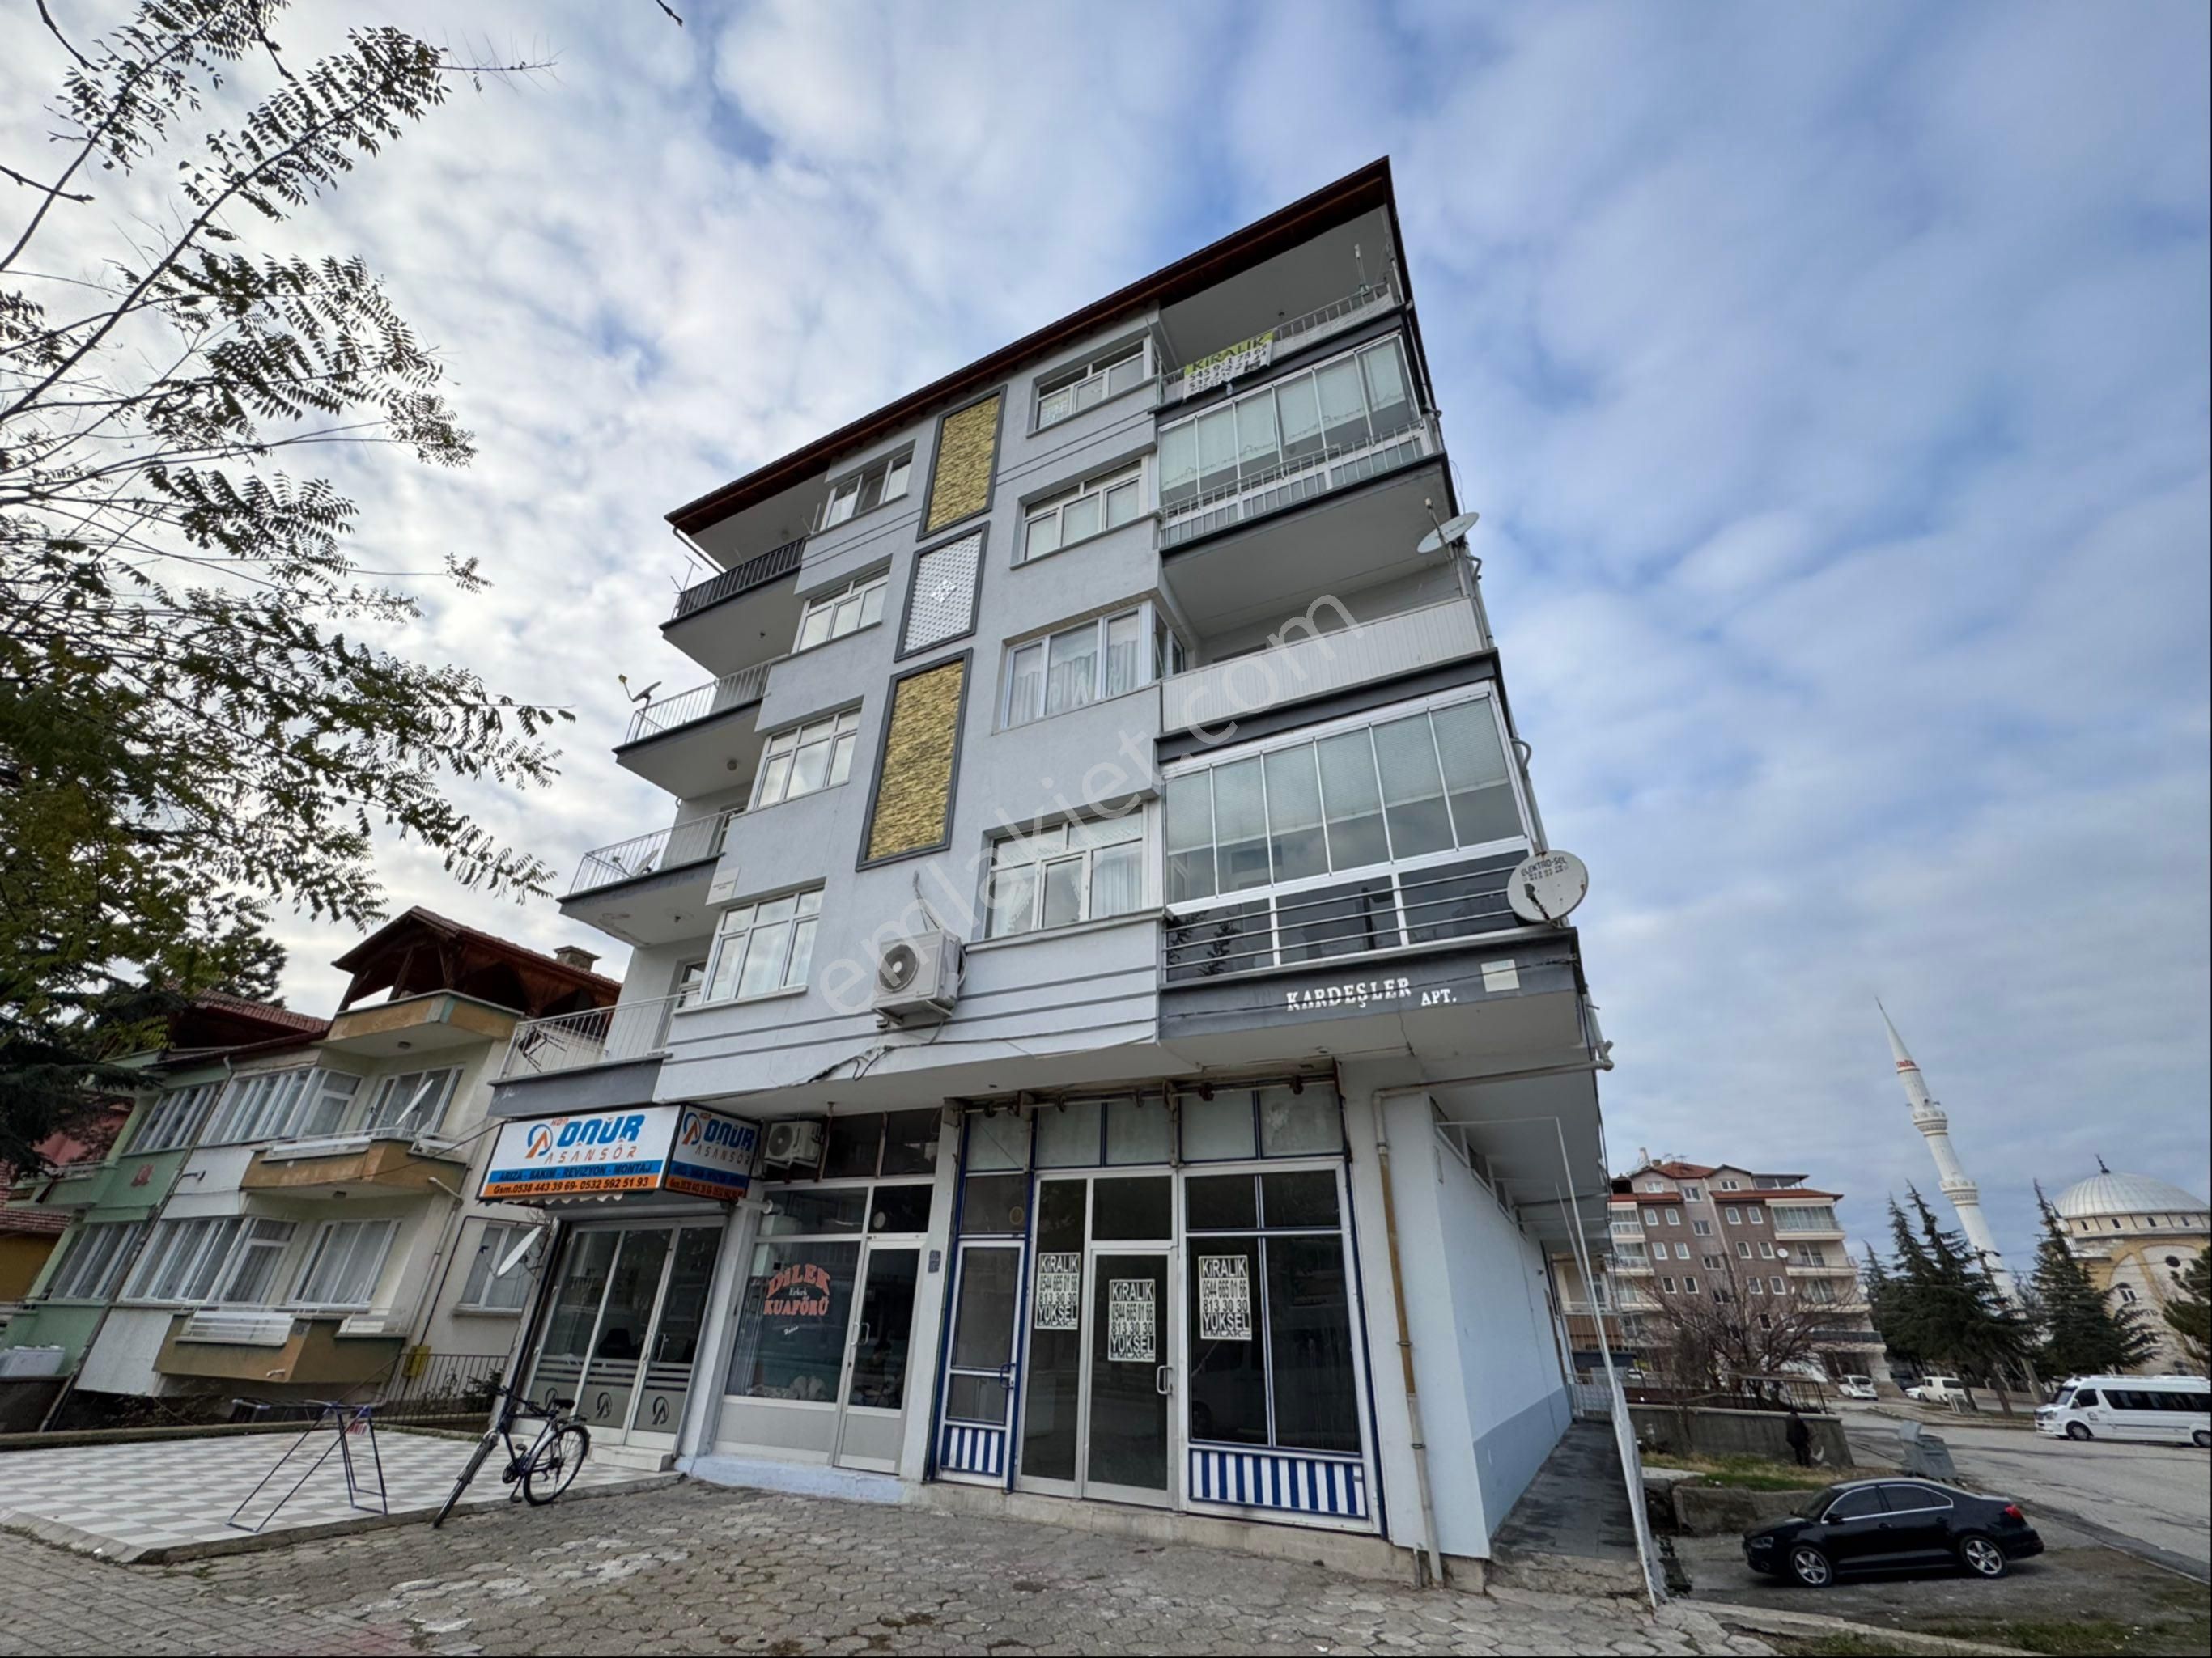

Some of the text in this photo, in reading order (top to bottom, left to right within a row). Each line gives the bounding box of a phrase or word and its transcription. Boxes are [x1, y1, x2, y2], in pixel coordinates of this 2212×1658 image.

[1286, 977, 1457, 1011] KARDEŞLER APT.
[556, 1114, 645, 1147] ONUR
[703, 1118, 756, 1152] ONUR
[614, 1164, 652, 1175] MONTAJ
[534, 1182, 550, 1192] 443
[551, 1181, 563, 1191] 39
[580, 1180, 602, 1190] 0532
[603, 1178, 621, 1189] 592
[622, 1177, 635, 1187] 51
[636, 1177, 649, 1186] 93
[763, 1295, 830, 1316] KUAFÖRÜ
[1038, 1292, 1077, 1304] 813 30 30
[1204, 1299, 1248, 1312] 813 30 30
[1111, 1321, 1153, 1334] 813 30 30
